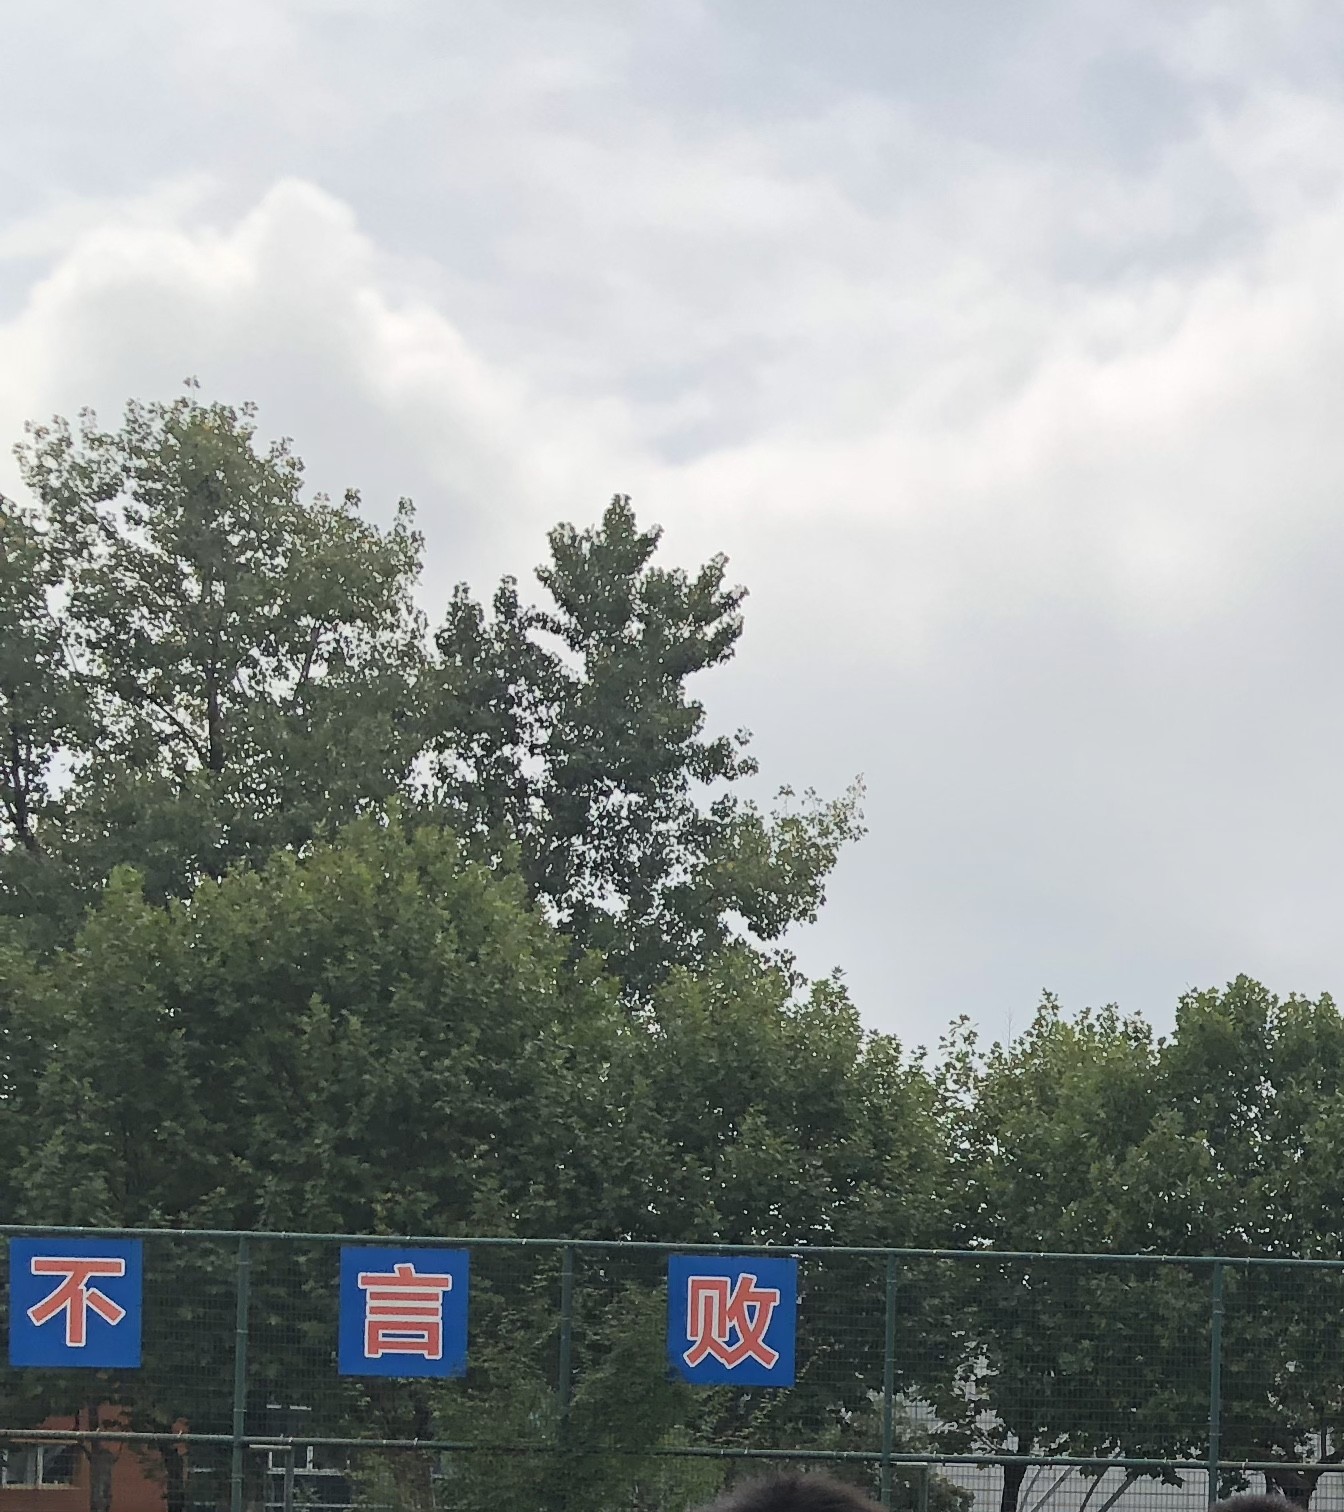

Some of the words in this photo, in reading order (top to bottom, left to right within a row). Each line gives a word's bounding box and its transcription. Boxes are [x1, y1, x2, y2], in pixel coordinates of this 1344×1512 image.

[27, 1256, 127, 1348] 不
[357, 1263, 452, 1360] 言
[682, 1272, 782, 1371] 败
